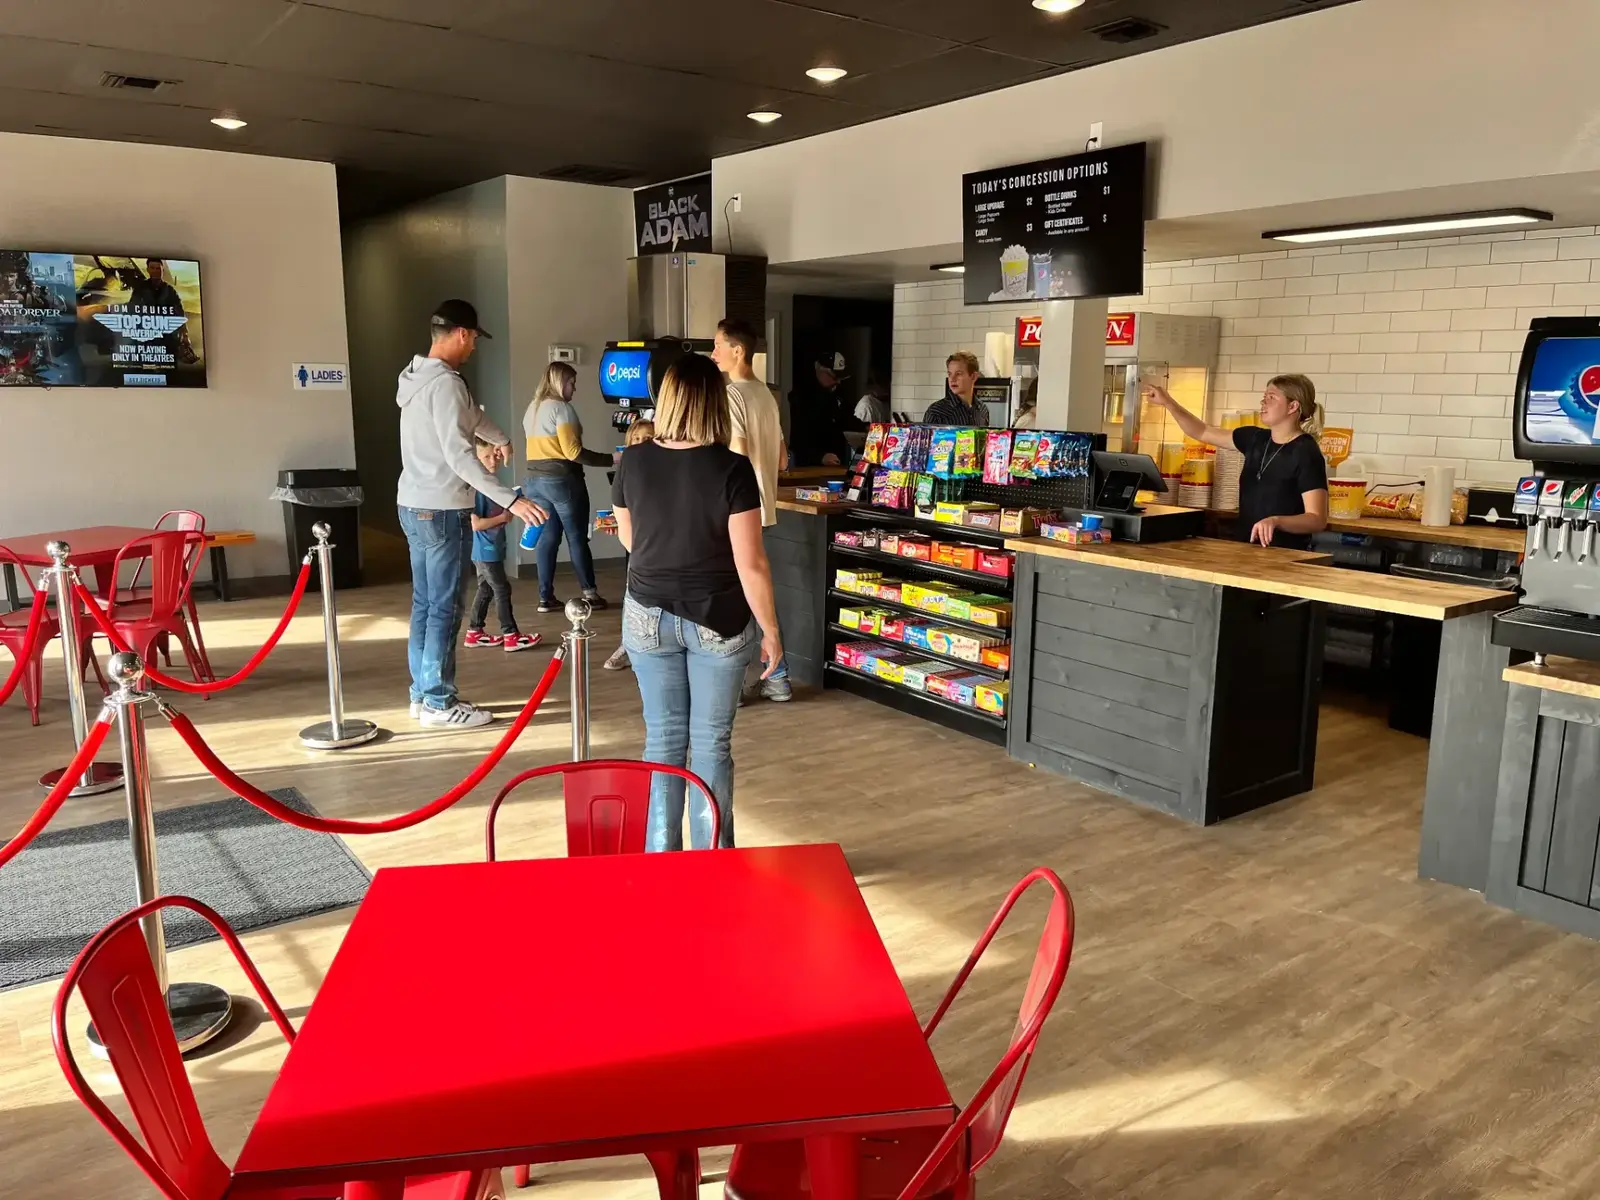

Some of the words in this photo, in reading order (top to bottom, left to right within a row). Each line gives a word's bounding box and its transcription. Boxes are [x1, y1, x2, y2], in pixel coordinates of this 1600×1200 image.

[972, 178, 1007, 195] TODAY'S
[1009, 169, 1065, 189] CONCESSION
[1066, 161, 1108, 180] OPTIONS
[1103, 186, 1110, 195] $1
[1026, 197, 1033, 206] $2
[648, 194, 700, 219] BLACK
[1044, 219, 1054, 229] GIFT
[1054, 216, 1083, 227] CERTIFICATES
[640, 211, 709, 247] ADAM
[1026, 223, 1033, 232] $3
[13, 308, 62, 317] FOREVER
[107, 304, 128, 313] TOM
[135, 305, 174, 315] CRUISE
[117, 315, 141, 330] TOP
[142, 315, 169, 330] GUN
[122, 329, 163, 338] MAVERICK
[119, 345, 136, 353] NOW
[138, 345, 166, 354] PLAYING
[112, 353, 130, 361] ONLY
[140, 354, 175, 362] THEATRES
[311, 370, 343, 380] LADIES
[617, 365, 641, 381] pepsi
[1321, 437, 1348, 446] OPCORN
